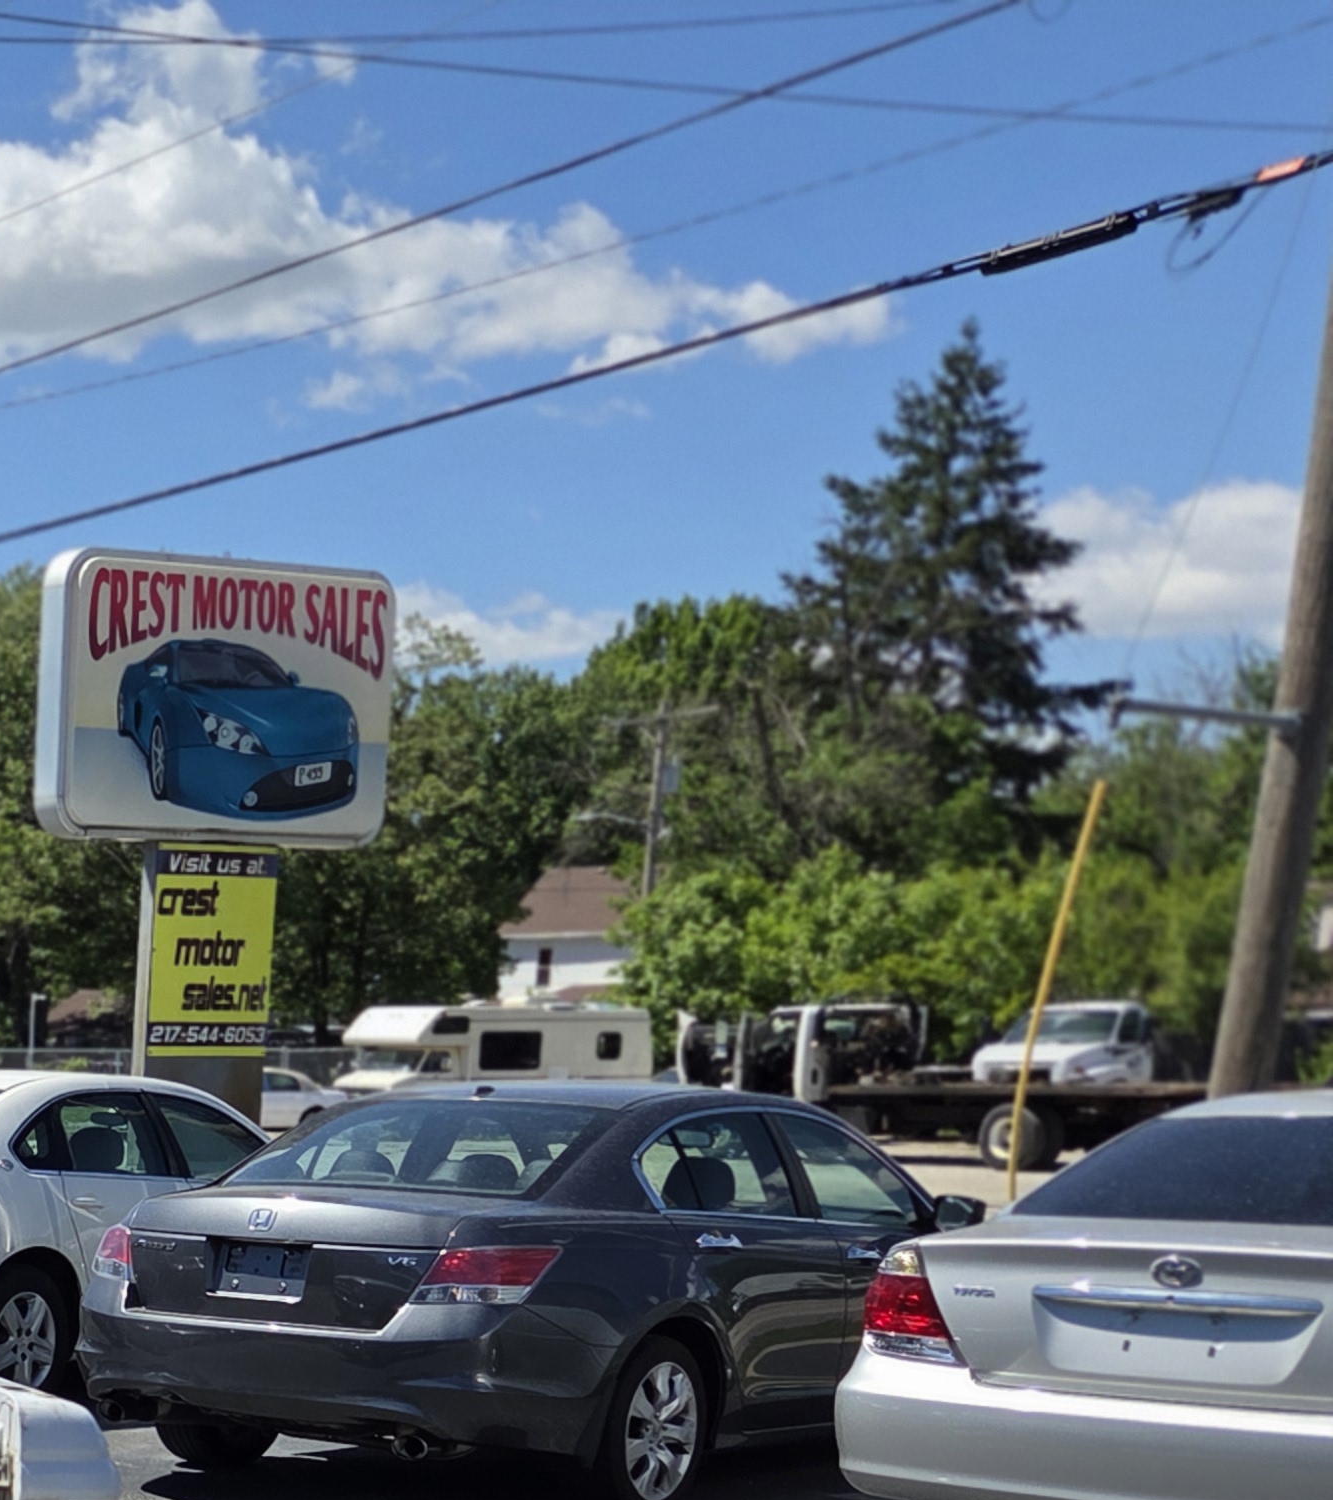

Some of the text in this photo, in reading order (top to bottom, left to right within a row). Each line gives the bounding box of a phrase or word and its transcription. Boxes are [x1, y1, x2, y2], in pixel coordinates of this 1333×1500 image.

[89, 567, 388, 681] CREST MOTOR SALES
[169, 853, 210, 873] Visit
[216, 857, 242, 873] us
[157, 880, 220, 916] crest
[174, 930, 245, 966] motor
[181, 976, 267, 1012] sales.net
[149, 1026, 266, 1043] 217-544-6053
